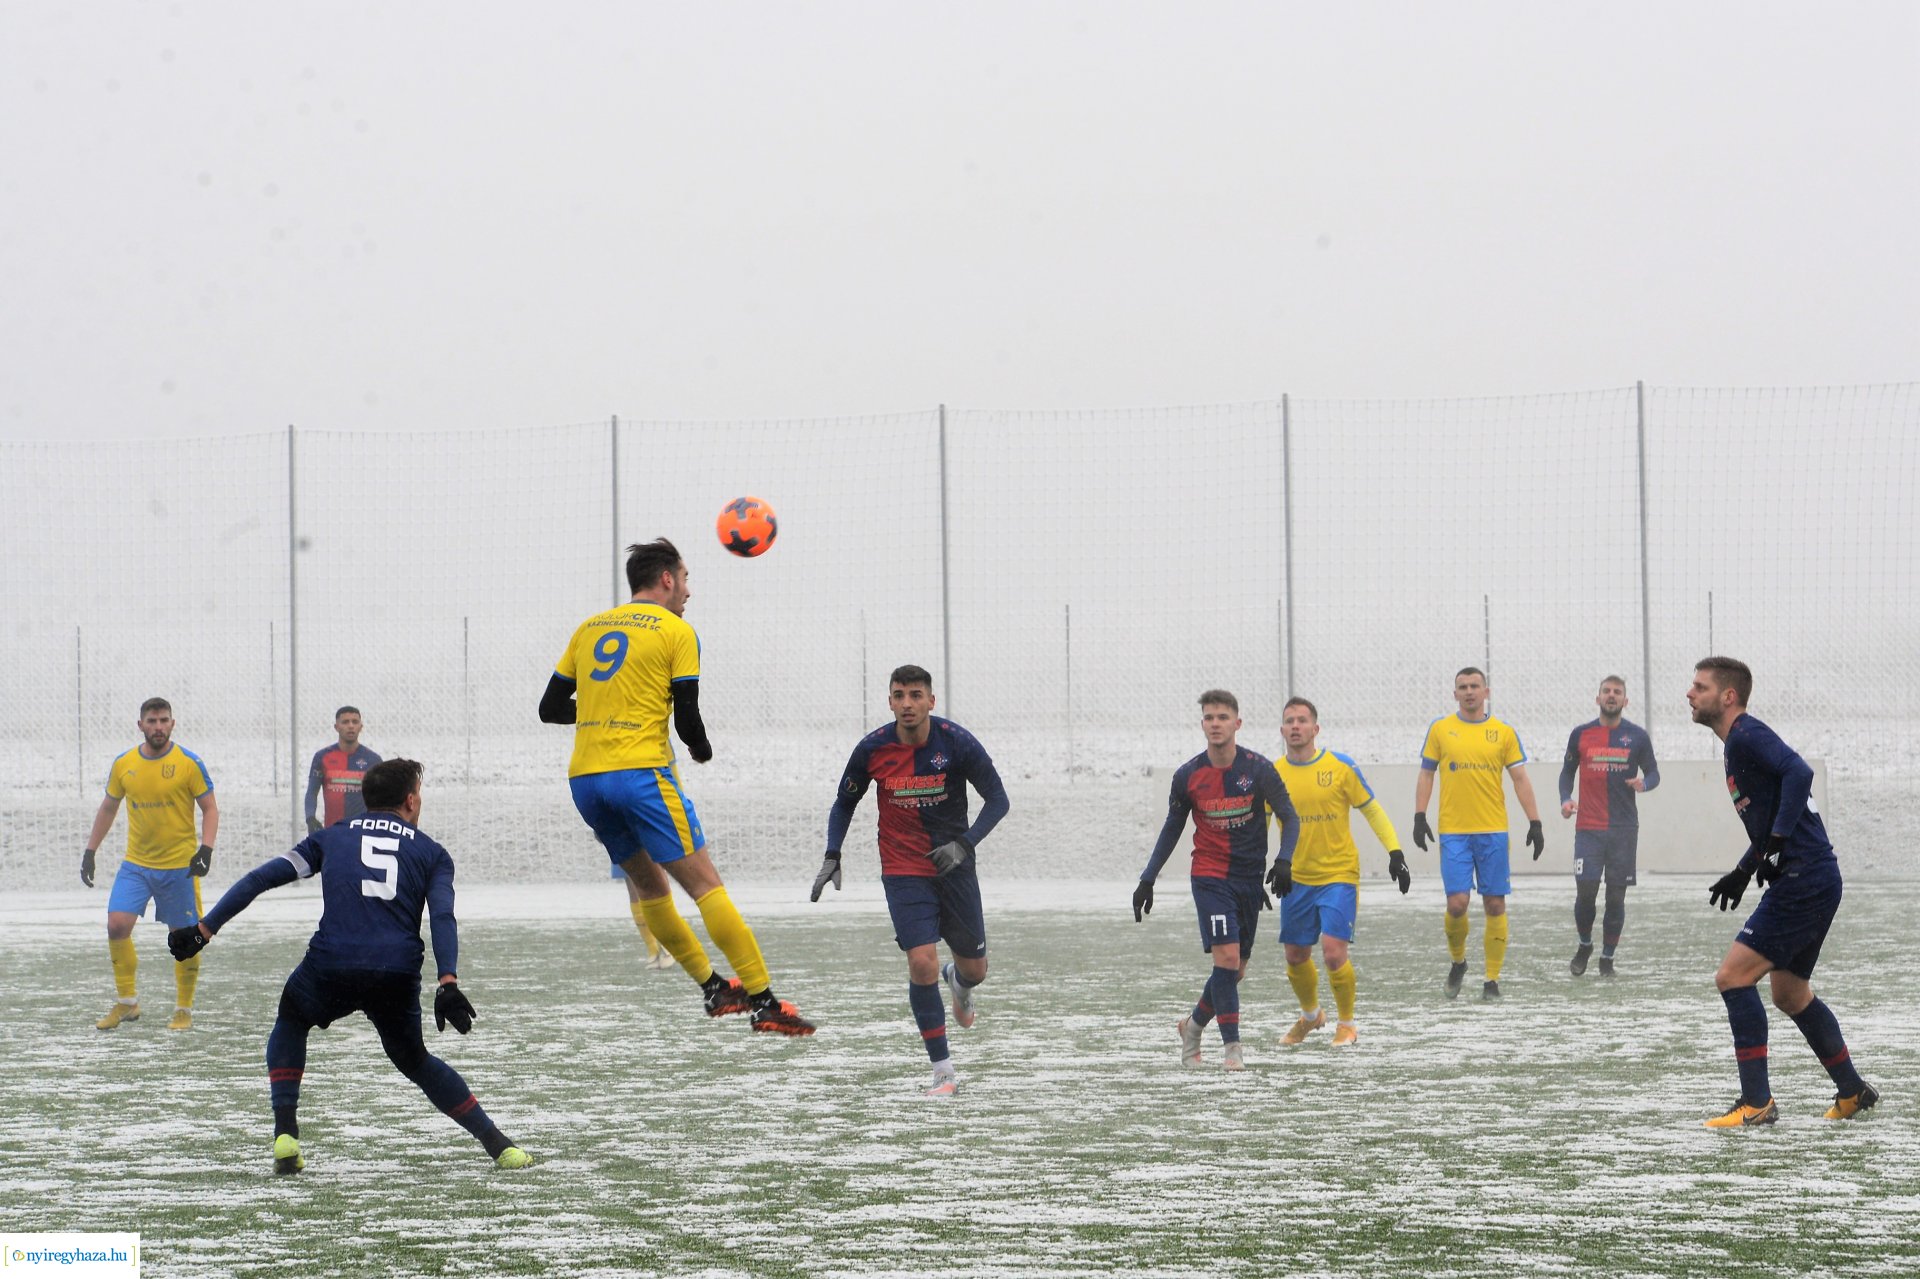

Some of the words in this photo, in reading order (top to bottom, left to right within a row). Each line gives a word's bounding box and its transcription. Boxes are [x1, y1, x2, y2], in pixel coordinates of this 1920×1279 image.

[589, 631, 629, 682] 9
[885, 773, 946, 790] REVESZ
[349, 818, 416, 840] FODOR
[361, 835, 400, 901] 5
[1210, 914, 1228, 937] 17
